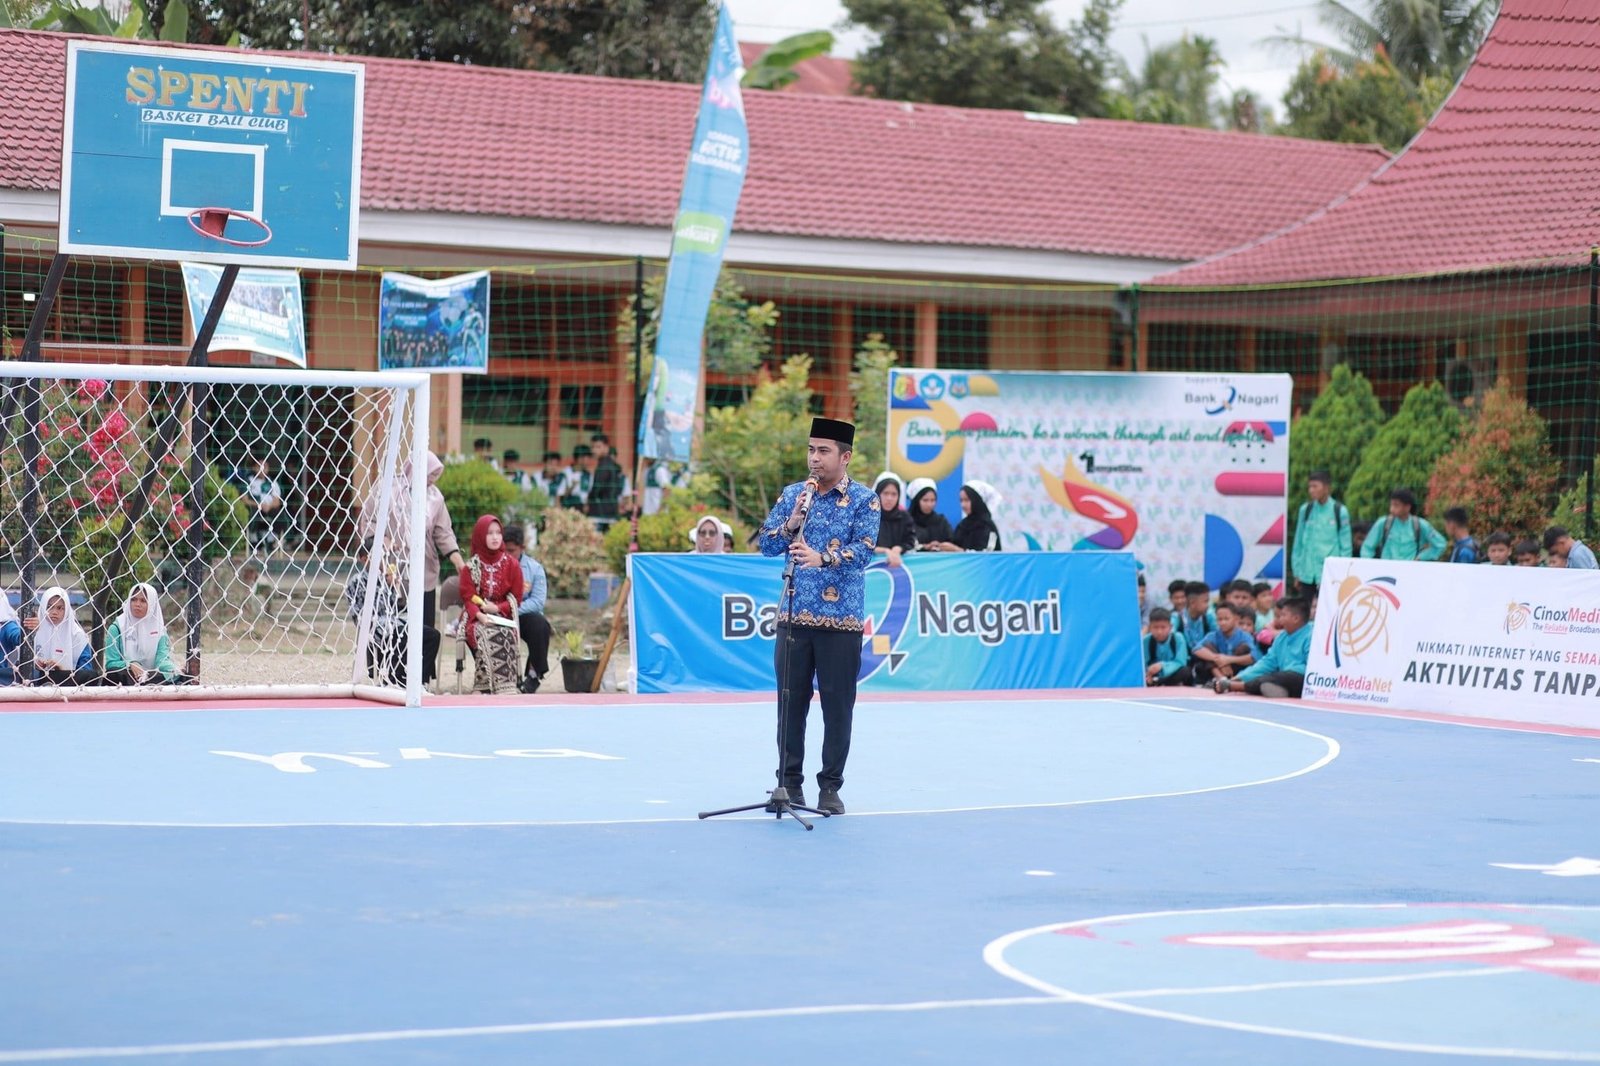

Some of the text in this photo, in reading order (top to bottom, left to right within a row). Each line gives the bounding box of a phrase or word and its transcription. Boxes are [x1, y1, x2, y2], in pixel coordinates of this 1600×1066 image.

[126, 67, 309, 118] SPENTI
[142, 109, 202, 123] BASKET
[1185, 393, 1279, 406] Bank Nagari
[916, 590, 1061, 645] Nagari
[1534, 605, 1600, 623] CinoxMedi
[1532, 623, 1543, 631] The
[1569, 625, 1600, 634] Broadban
[1416, 641, 1600, 666] NIKMATI INTERNET YANG SEMA
[1306, 672, 1393, 693] CinoxMediaNet
[1404, 660, 1524, 691] AKTIVITAS
[1304, 687, 1314, 696] The
[1338, 691, 1368, 701] Broadband
[1370, 694, 1389, 704] Access
